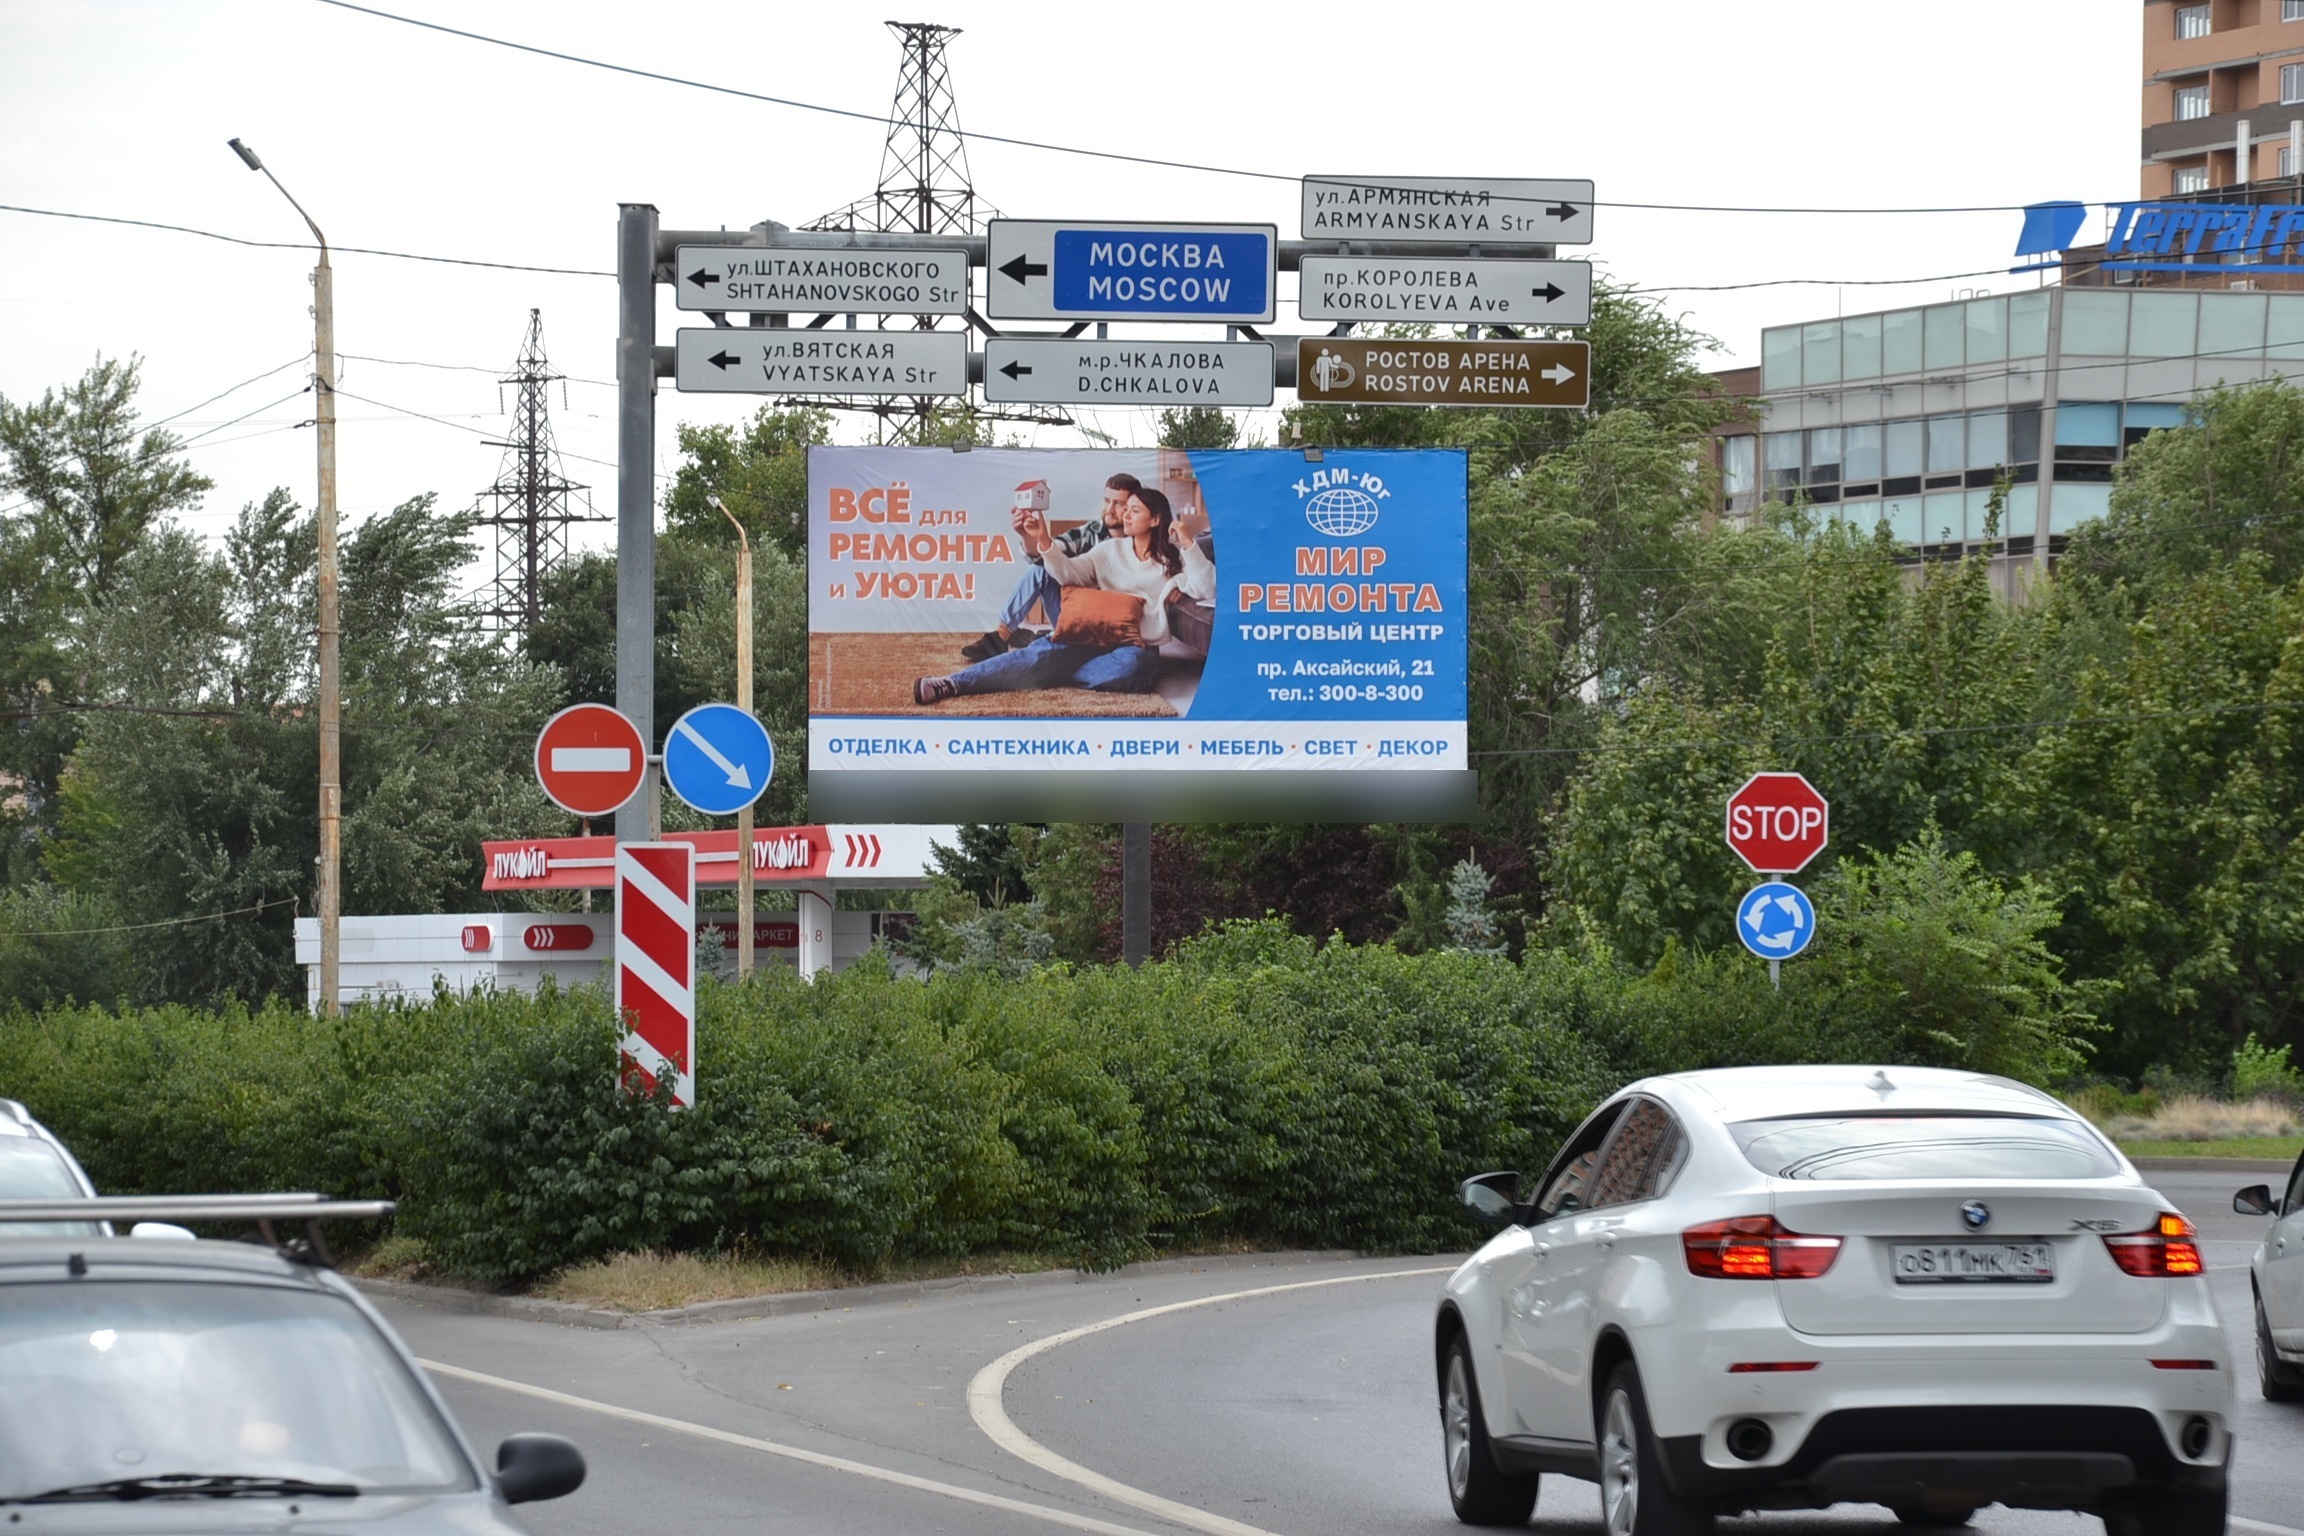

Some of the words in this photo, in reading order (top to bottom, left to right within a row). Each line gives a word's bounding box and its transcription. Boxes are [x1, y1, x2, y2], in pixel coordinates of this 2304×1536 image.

[1315, 188, 1491, 207] ул.АРМЯНСКАЯ
[1315, 211, 1490, 231] ARMYANSKAYA
[1500, 215, 1535, 231] Str
[1089, 242, 1225, 269] МОСКВА
[727, 260, 940, 279] ул.ШТАХАНОВСКОГО
[1323, 270, 1479, 288] пр.КОРОЛЕВА
[727, 283, 920, 302] SHTAHANOVSKOGO
[929, 287, 959, 303] Str
[1088, 276, 1231, 303] MOSCOW
[1323, 292, 1458, 311] KOROLYEVA
[1469, 296, 1510, 312] Ave
[763, 342, 894, 361] ул.ВЯТСКАЯ
[1365, 351, 1450, 369] РОСТОВ
[1459, 353, 1531, 370] АРЕНА
[1078, 353, 1224, 372] м.р.ЧКАЛОВА
[763, 365, 895, 382] VYATSKAYA
[905, 367, 937, 383] Str
[1078, 376, 1220, 394] D.CHKALOVA
[1365, 375, 1450, 392] ROSTOV
[1459, 376, 1530, 394] ARENA
[829, 481, 912, 524] ВСЁ
[919, 510, 968, 528] для
[829, 532, 1015, 564] РЕМОНТА
[1296, 547, 1386, 576] МИР
[830, 583, 846, 599] и
[855, 572, 975, 601] УЮТА!
[1239, 583, 1443, 613] РЕМОНТА
[1239, 622, 1363, 641] ТОРГОВЫЙ
[1370, 625, 1444, 643] ЦЕНТР
[1257, 664, 1287, 679] пр.
[1293, 659, 1406, 679] Аксайский,
[1411, 660, 1434, 676] 21
[1268, 688, 1314, 701] тел.:
[1319, 685, 1424, 702] 300-8-300
[828, 739, 927, 755] ОТДЕЛКА
[948, 739, 1090, 756] САНТЕХНИКА
[1110, 740, 1180, 757] ДВЕРИ
[1200, 740, 1284, 756] МЕБЕЛЬ
[1304, 740, 1358, 756] СВЕТ
[1378, 740, 1448, 757] ДЕКОР
[1732, 805, 1822, 841] STOP
[814, 929, 823, 943] 8
